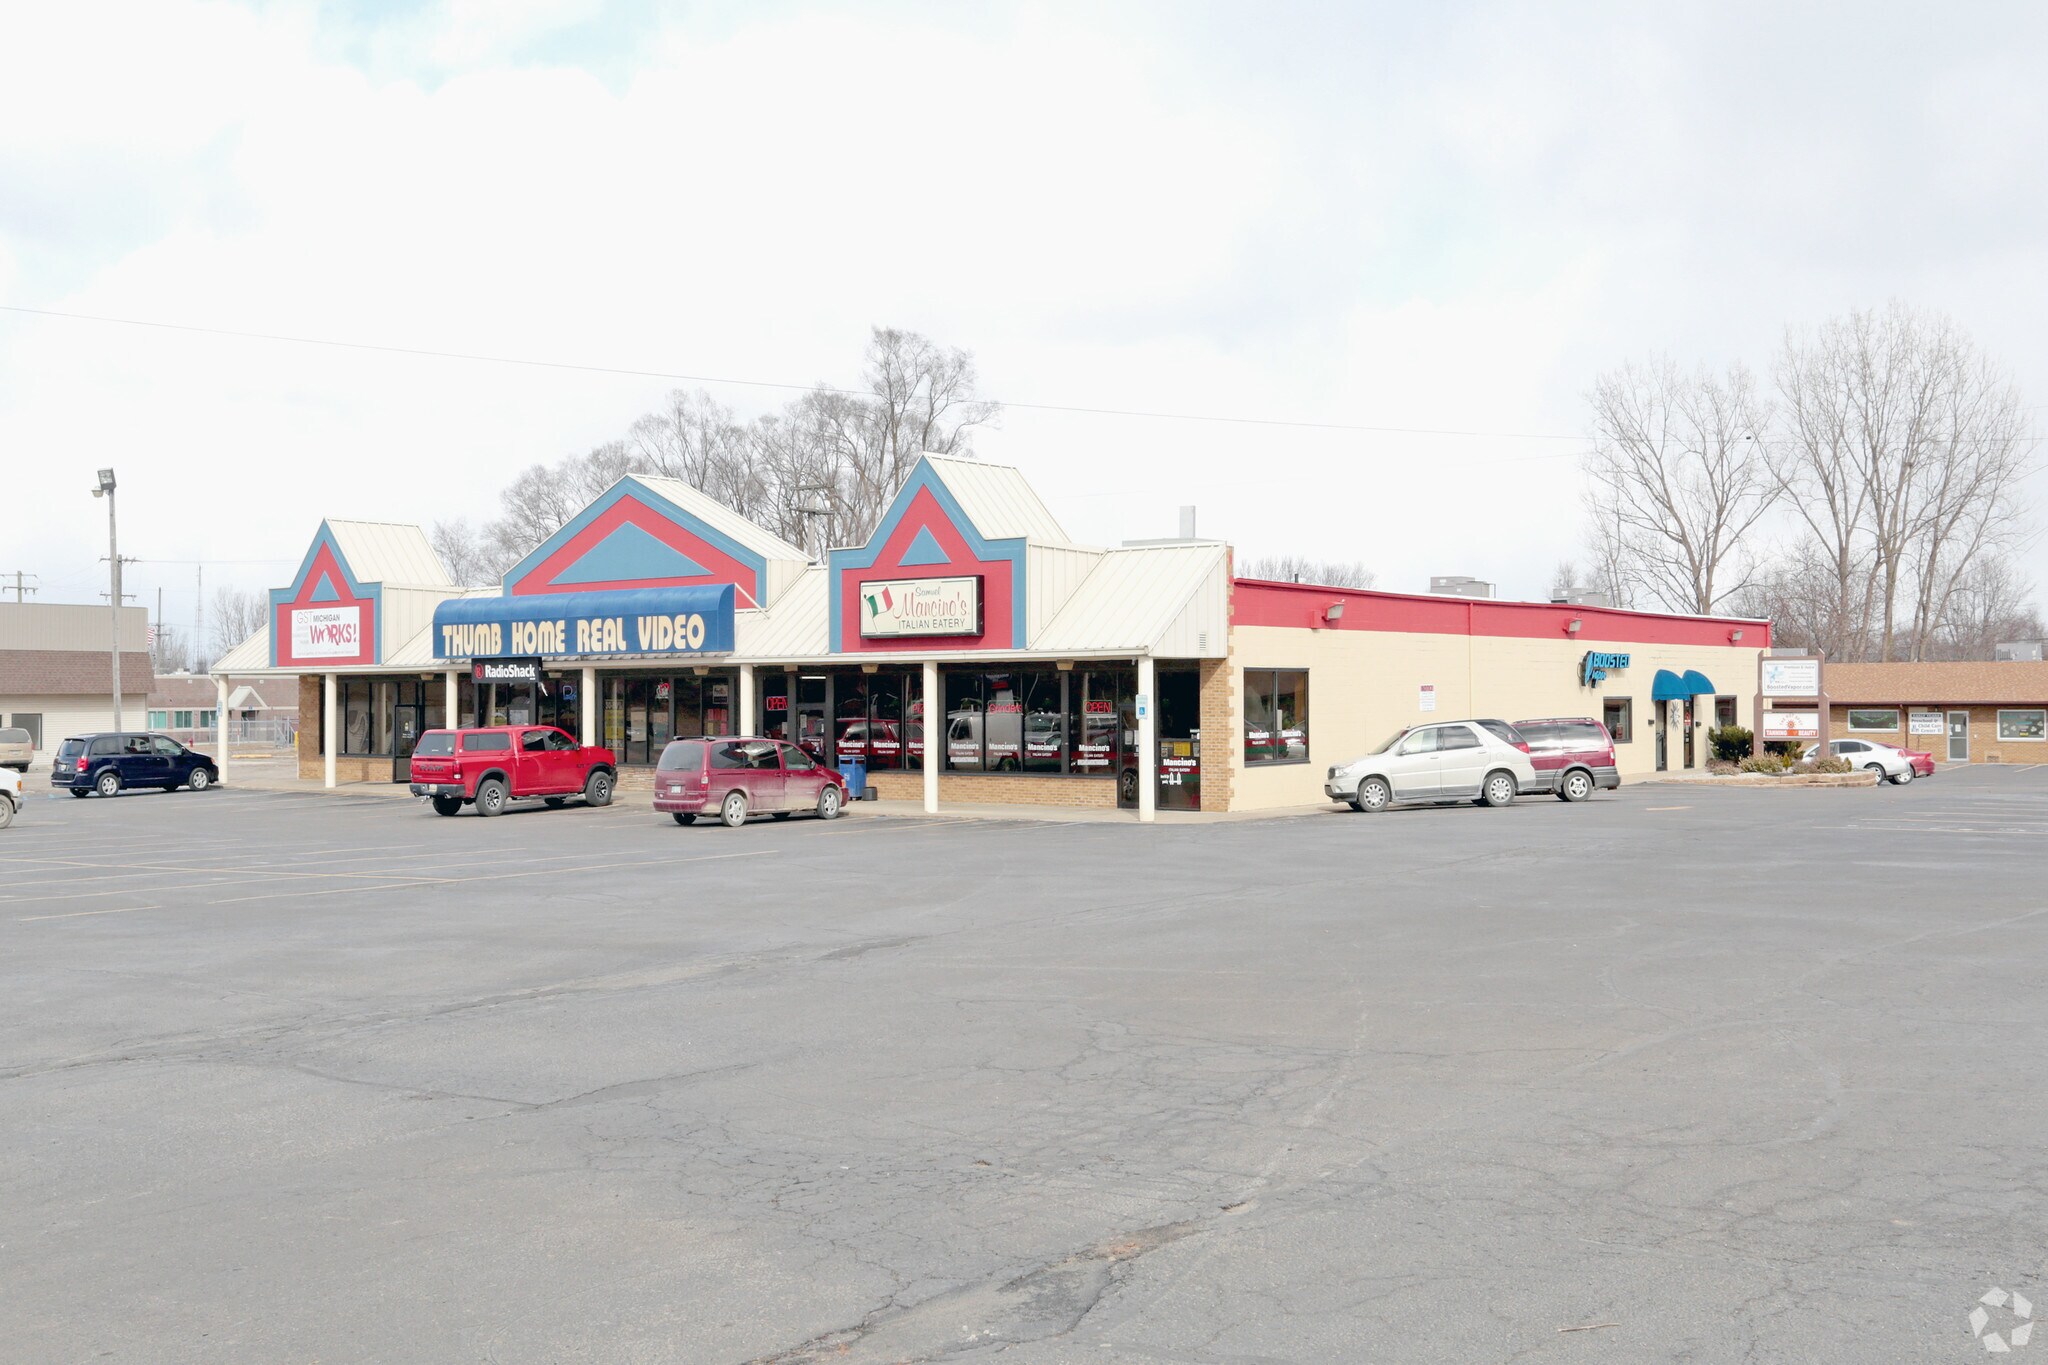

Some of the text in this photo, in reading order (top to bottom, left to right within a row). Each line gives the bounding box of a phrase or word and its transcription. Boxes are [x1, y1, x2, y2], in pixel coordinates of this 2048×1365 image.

[915, 586, 941, 597] Samuel
[893, 591, 967, 619] Mancino's
[297, 611, 340, 624] GST MICHIGAN
[899, 618, 966, 630] ITALIAN EATERY
[442, 613, 705, 656] THUMB HOME REAL VIDEO
[1593, 652, 1630, 669] BOOSTED
[485, 663, 536, 678] RadioShack
[1085, 701, 1111, 714] OPEN
[1079, 743, 1110, 752] Mancino's
[1163, 757, 1197, 766] Mancino's
